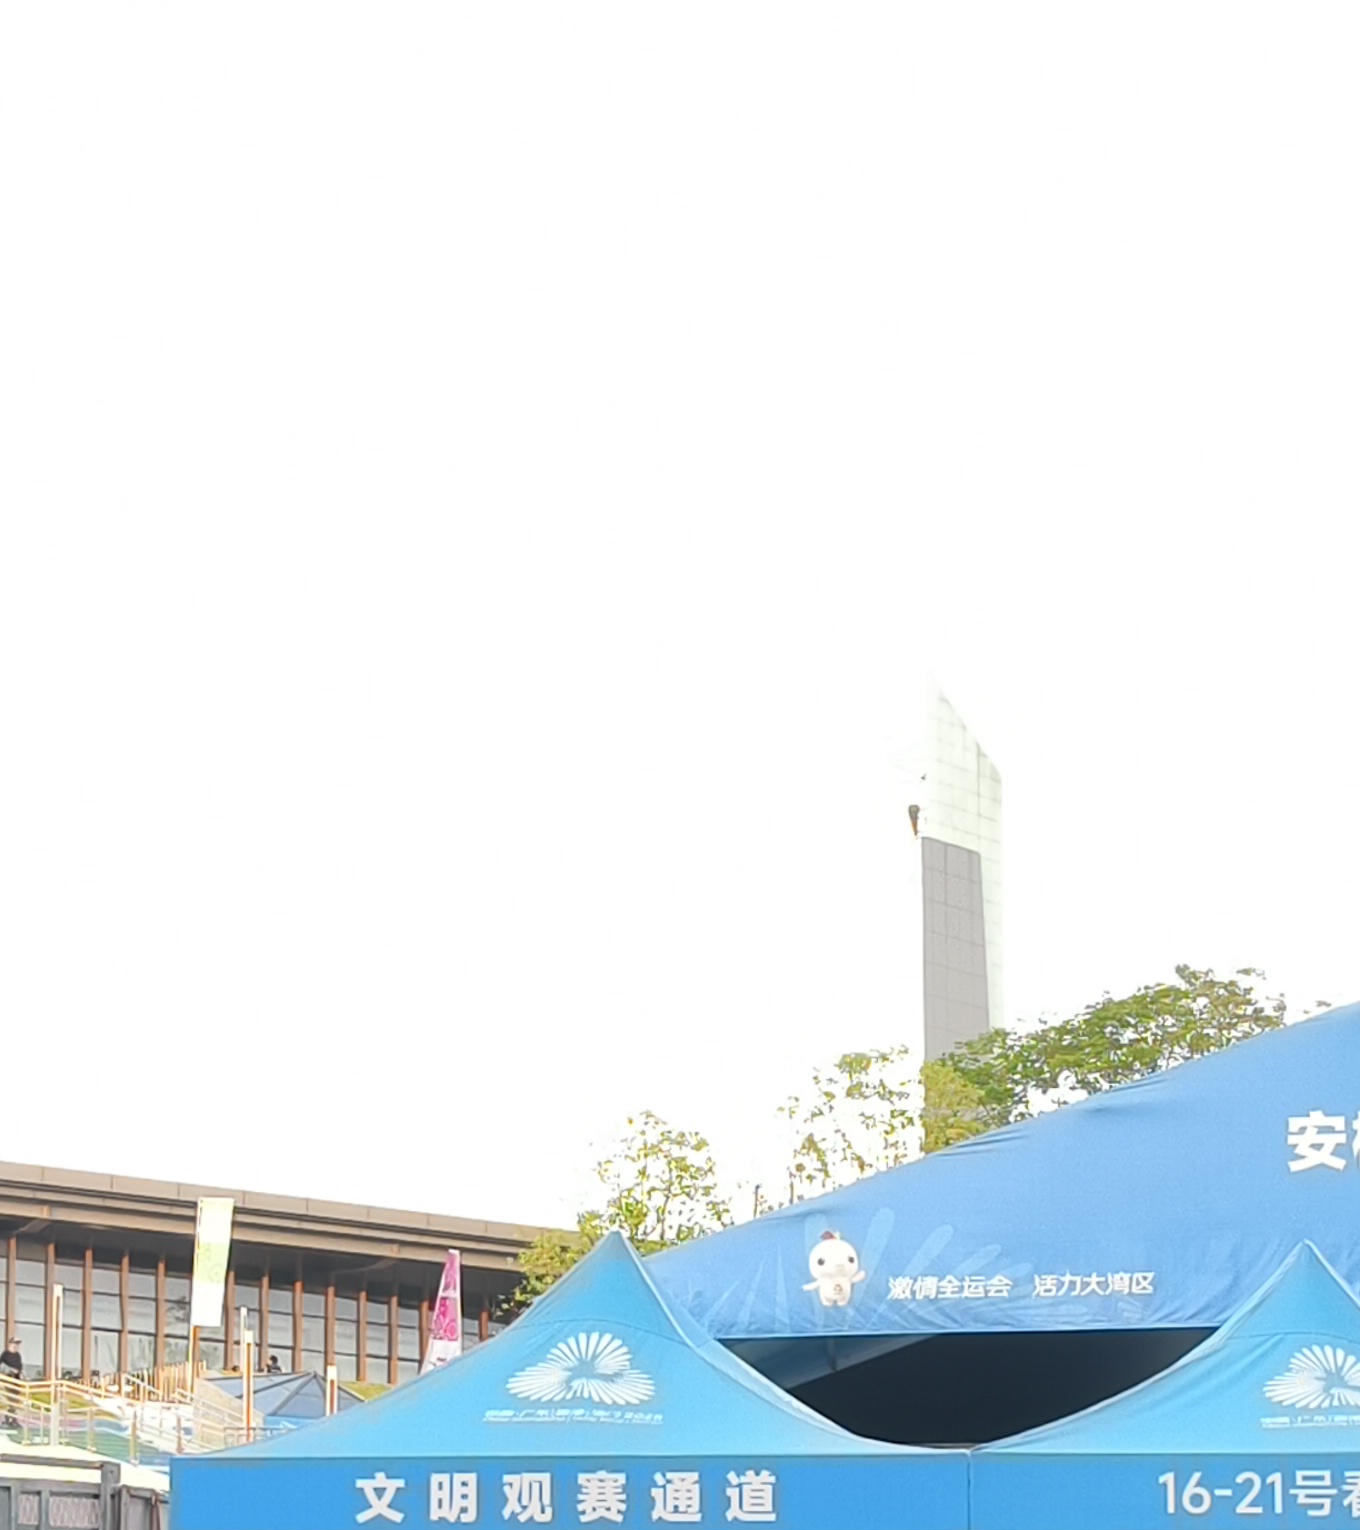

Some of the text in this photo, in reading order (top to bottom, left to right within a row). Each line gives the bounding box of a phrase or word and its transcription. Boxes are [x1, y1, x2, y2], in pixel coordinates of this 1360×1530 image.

[1033, 1271, 1155, 1297] 活力大湾区
[354, 1469, 778, 1525] 文明观赛通道
